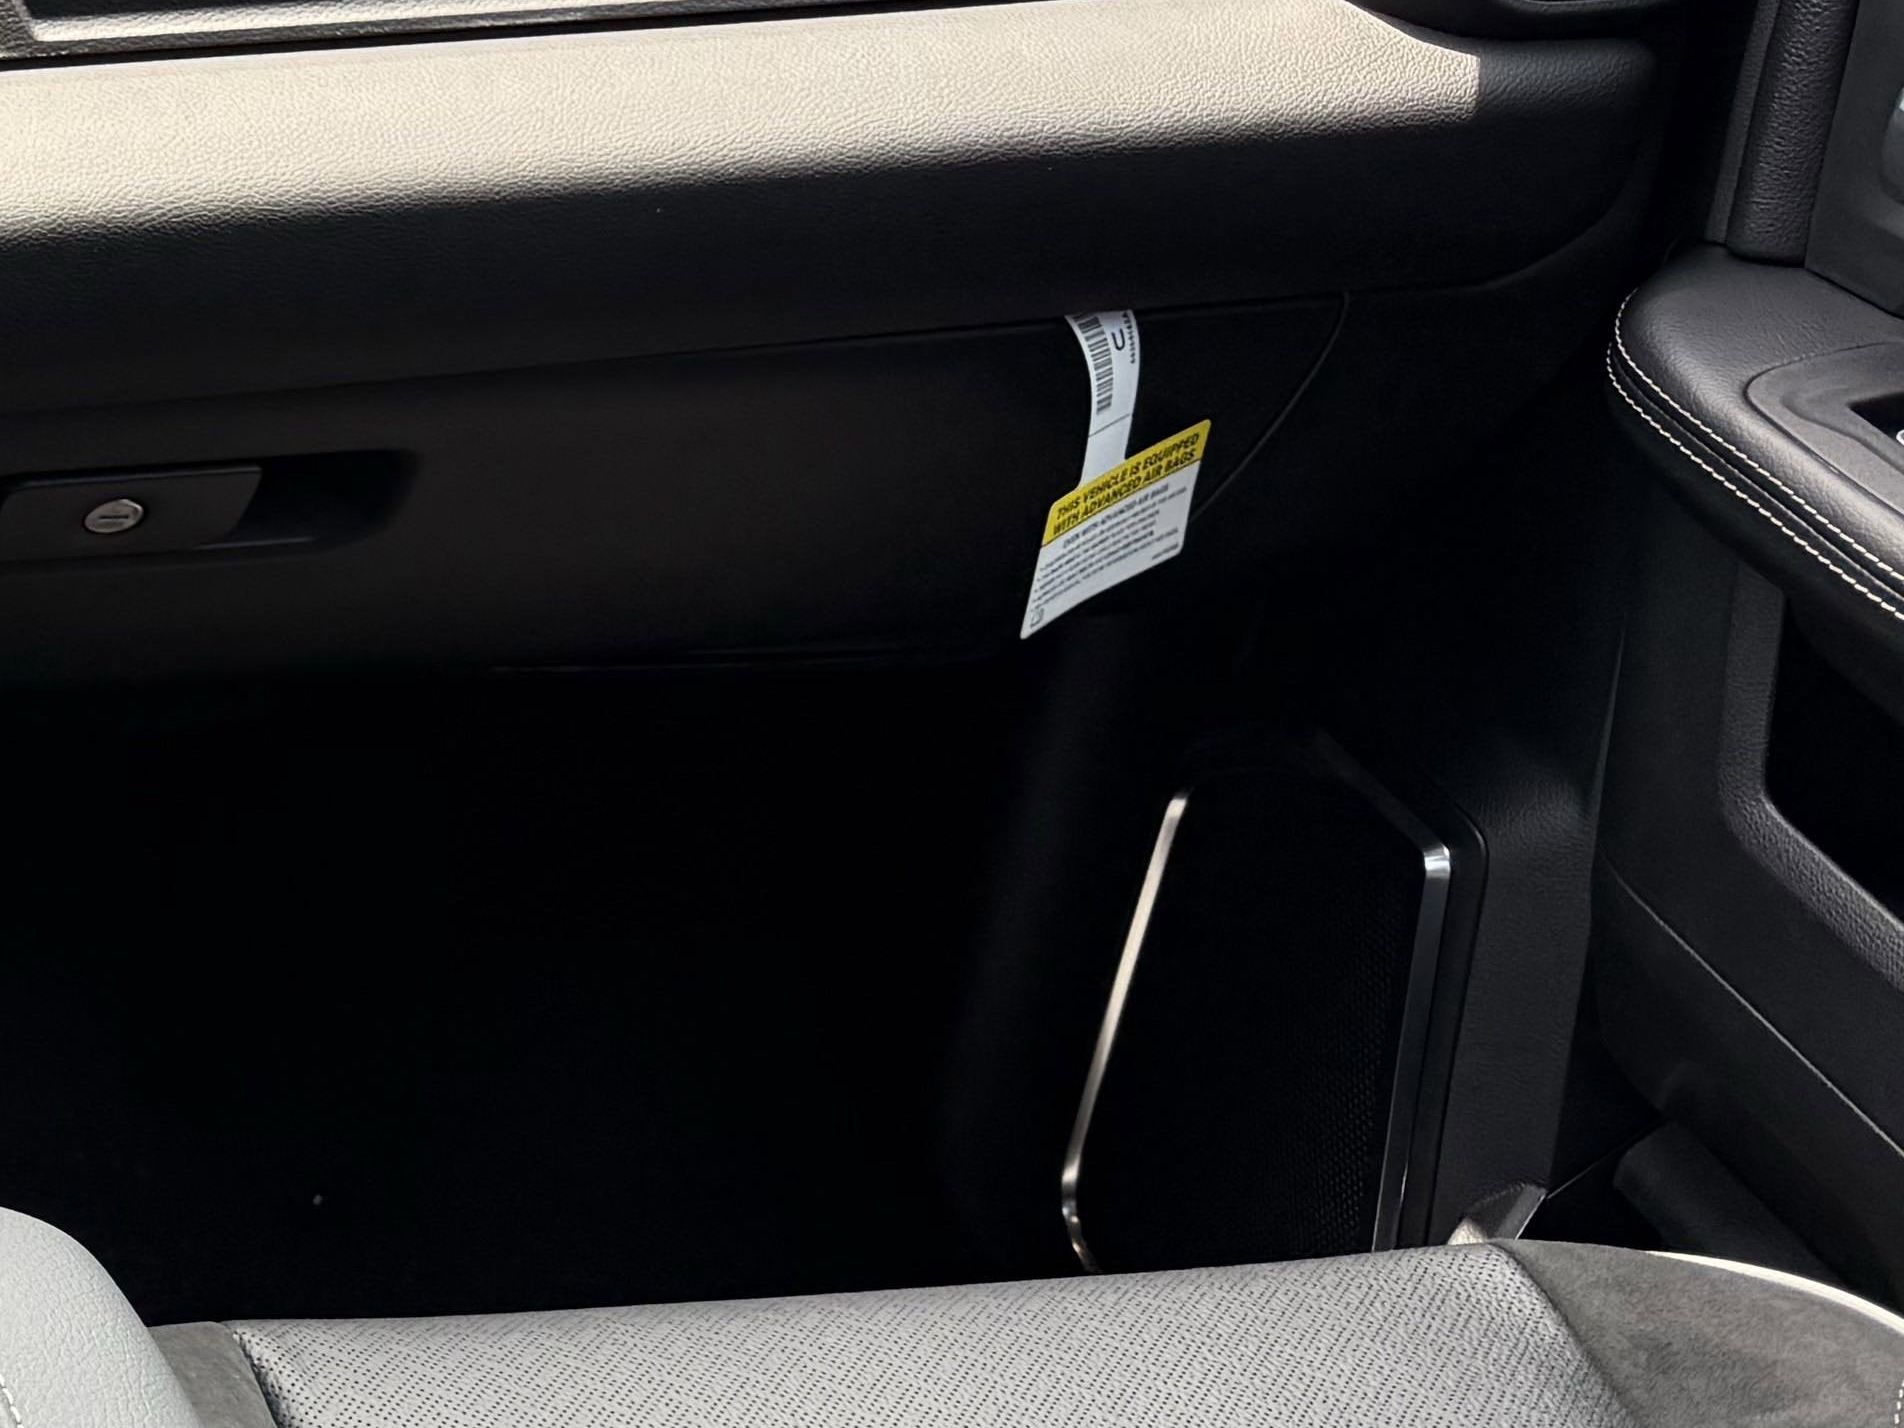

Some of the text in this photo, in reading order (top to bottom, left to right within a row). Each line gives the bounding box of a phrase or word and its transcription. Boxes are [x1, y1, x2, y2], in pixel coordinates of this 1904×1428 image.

[1052, 449, 1197, 535] WITH ADVANCED AIR BAGS
[1057, 432, 1201, 521] THIS VEHICLE IS EQUIPPED
